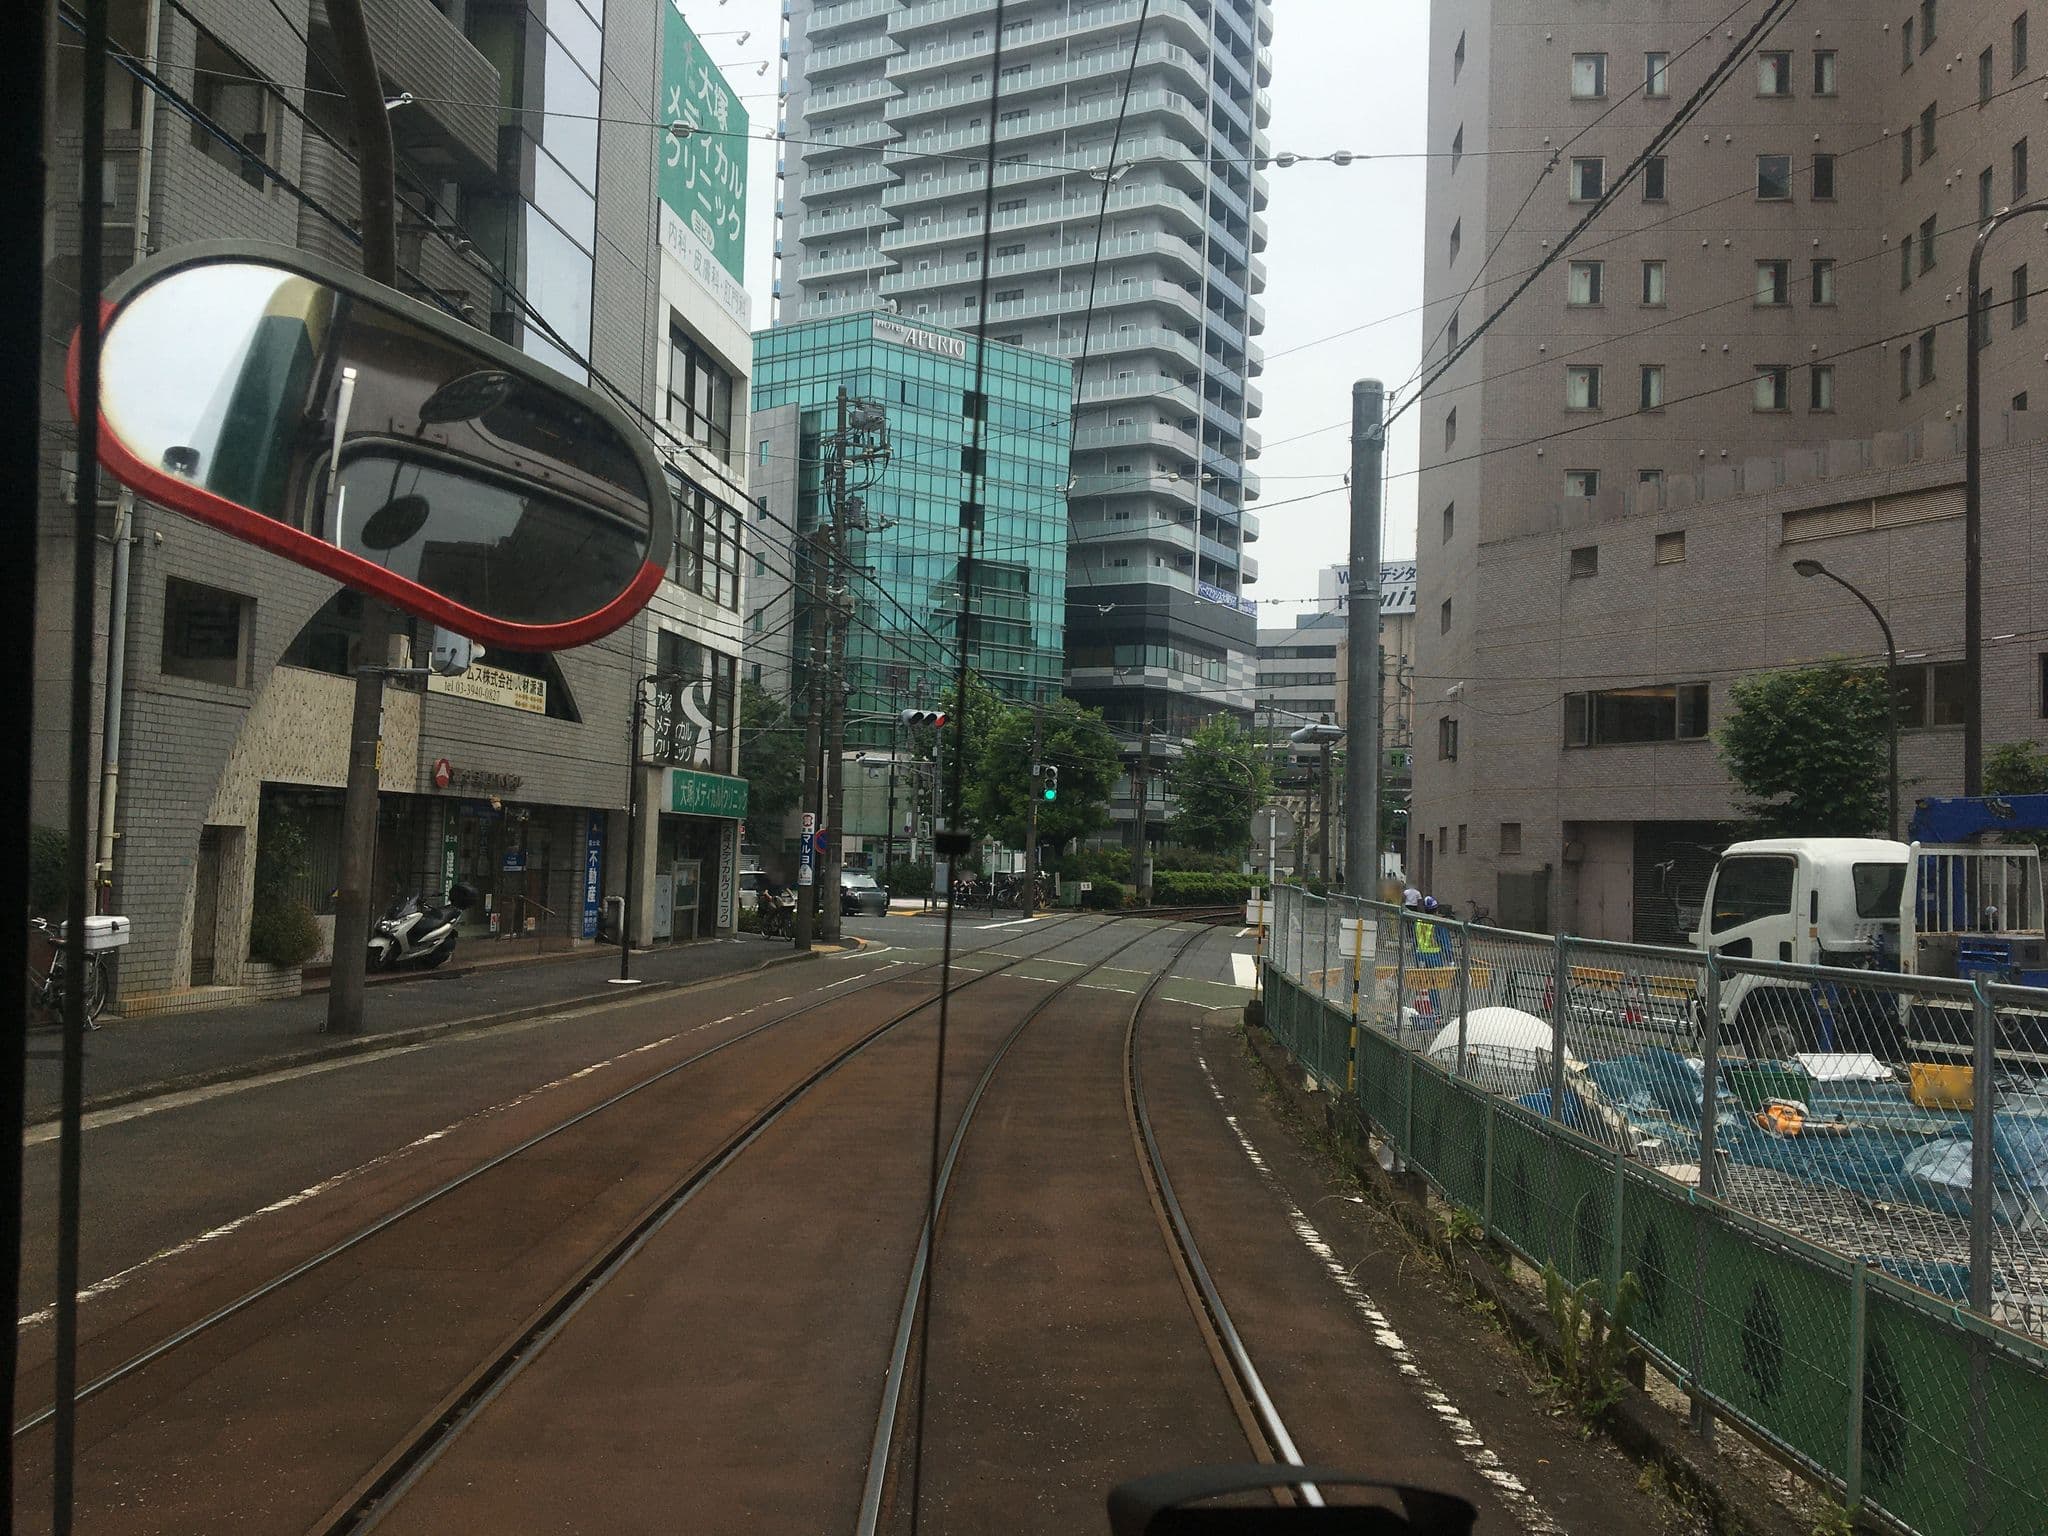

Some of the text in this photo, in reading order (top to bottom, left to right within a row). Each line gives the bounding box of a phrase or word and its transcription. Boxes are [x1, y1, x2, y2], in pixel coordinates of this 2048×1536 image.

[698, 66, 730, 132] 大塚
[667, 84, 744, 200] メディカル
[665, 133, 741, 241] クリニック
[905, 328, 965, 357] APERIO
[587, 850, 598, 902] 不動産
[801, 834, 811, 864] マルヨ
